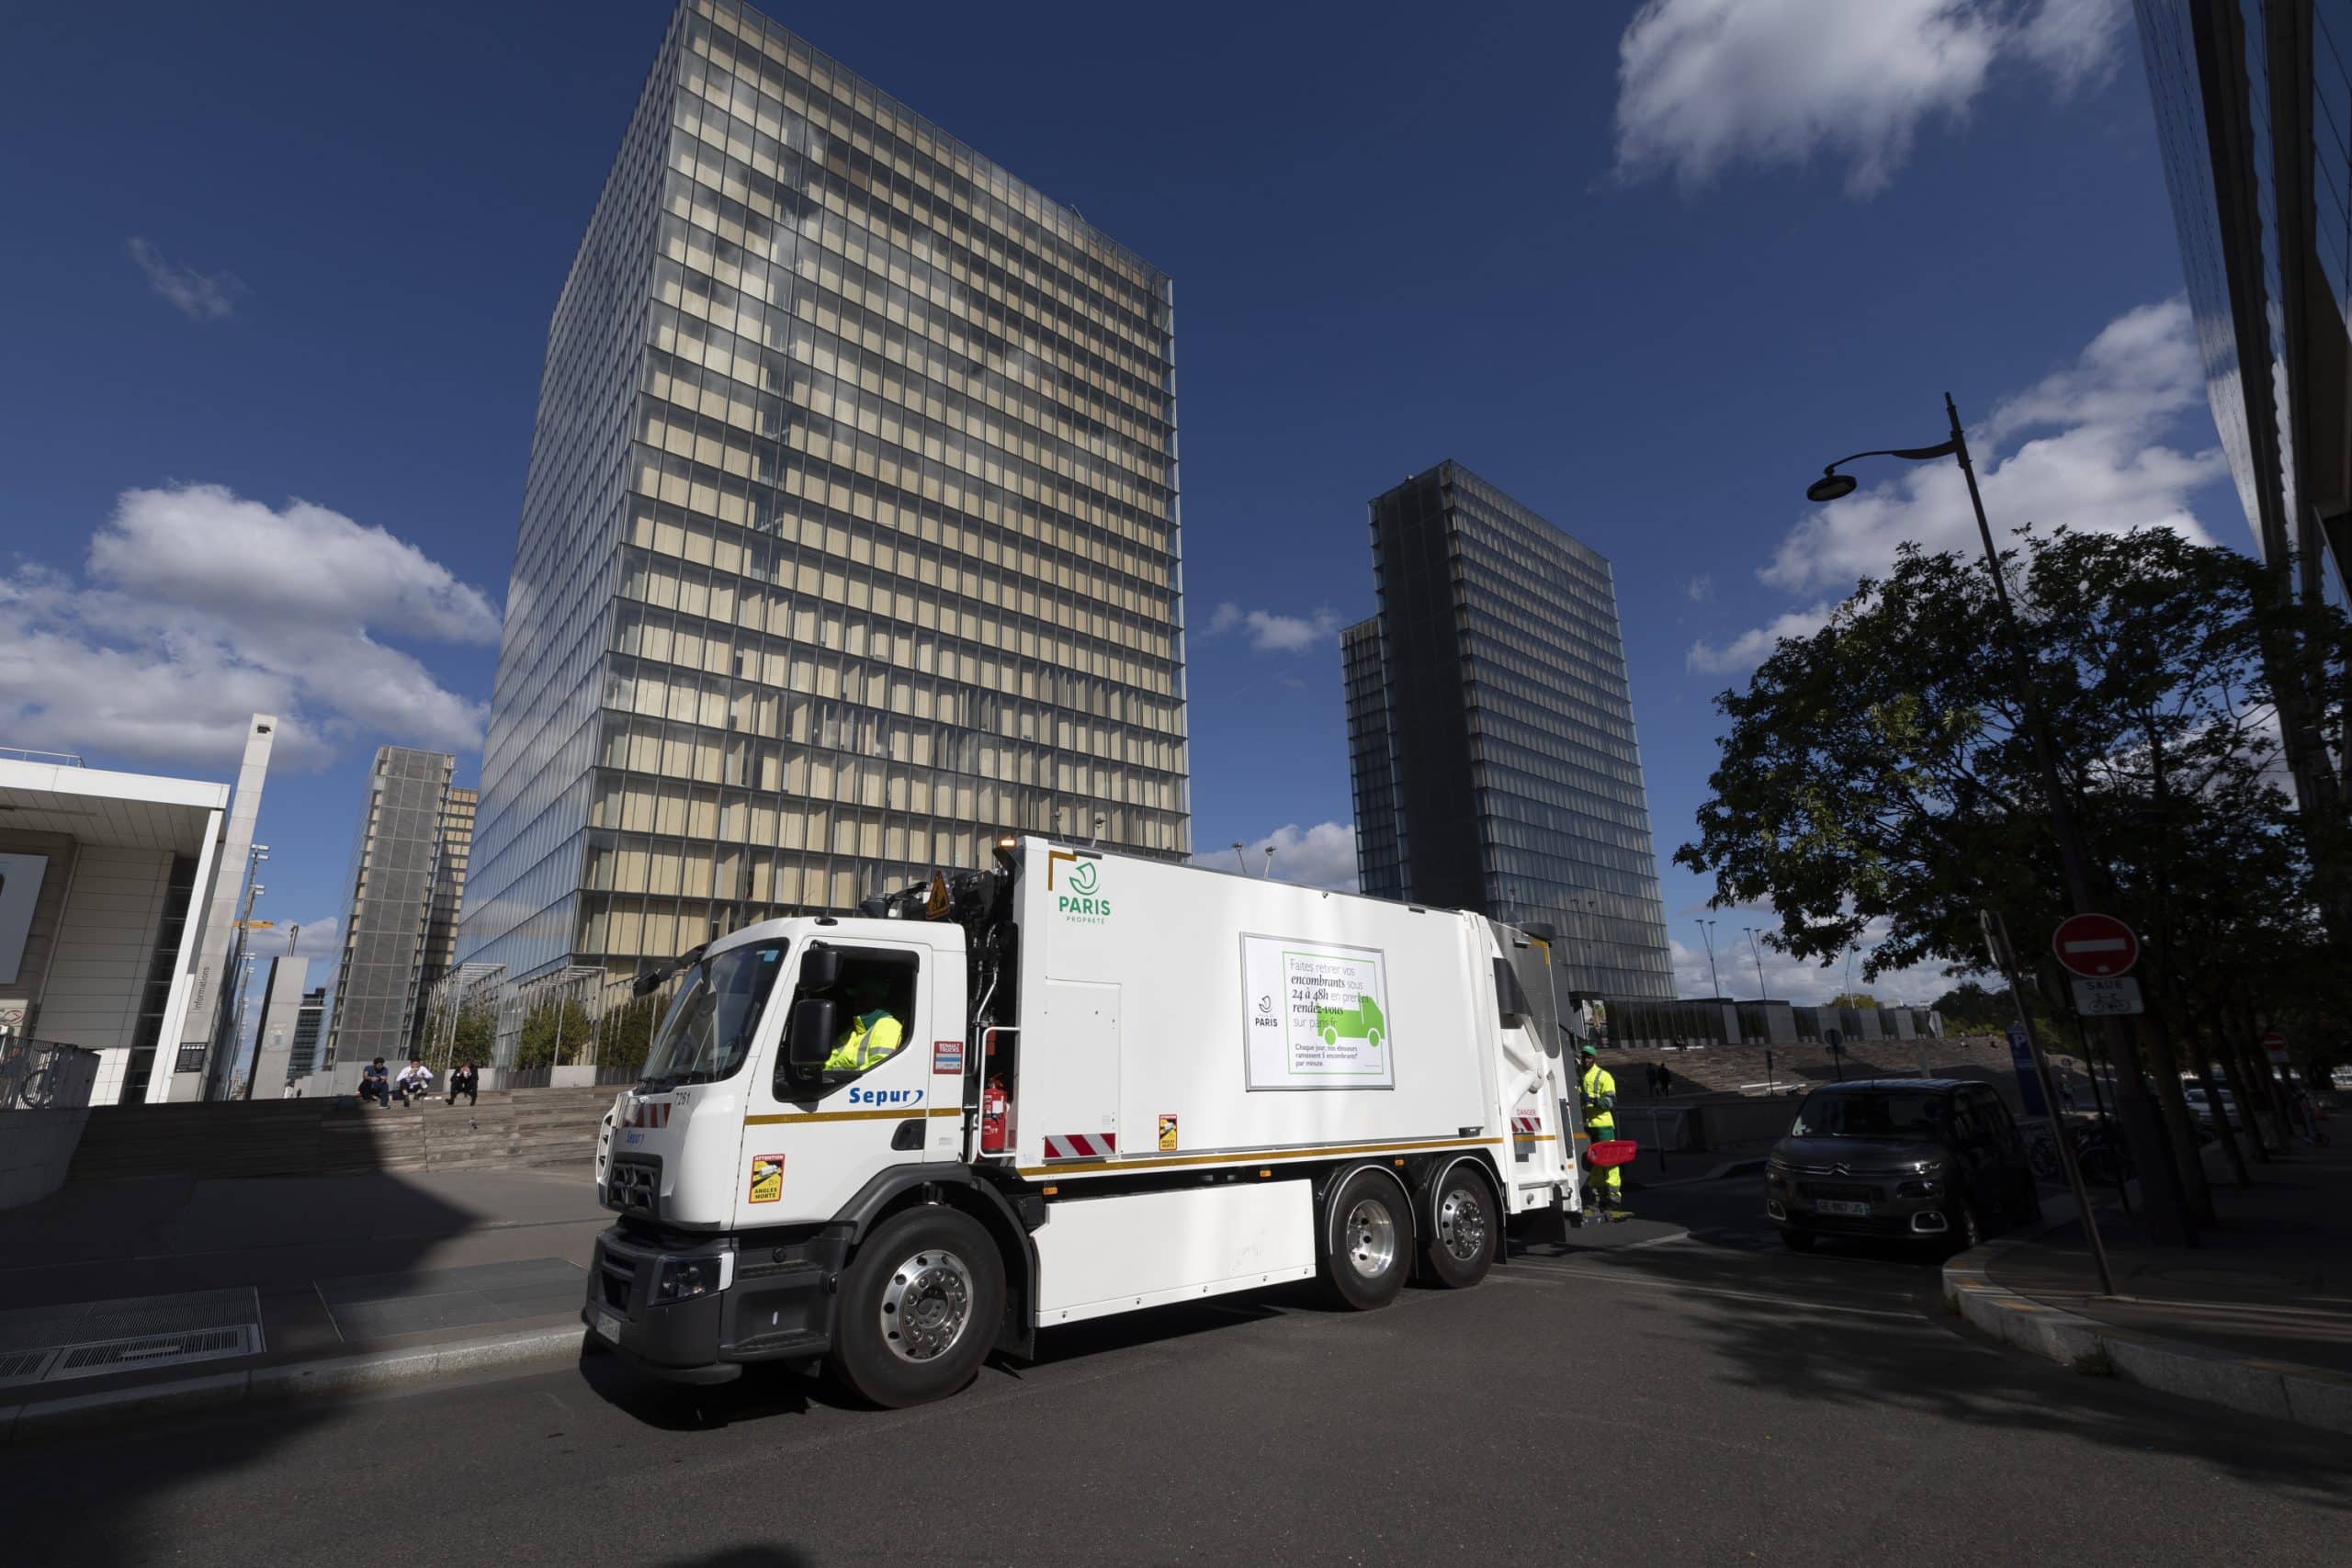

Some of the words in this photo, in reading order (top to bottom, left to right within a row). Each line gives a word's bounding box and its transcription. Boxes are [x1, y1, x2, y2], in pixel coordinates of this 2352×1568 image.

[1058, 896, 1111, 917] PARIS
[1290, 958, 1315, 972] Faites
[1316, 962, 1342, 974] retirer
[1342, 966, 1356, 976] vos
[193, 966, 210, 1010] Informations
[1291, 974, 1345, 988] encombrants
[1347, 980, 1363, 990] sous
[2086, 979, 2123, 990] SAUF
[1292, 988, 1303, 1000] 24
[1313, 988, 1329, 1001] 48h
[1330, 992, 1340, 1001] en
[1293, 1001, 1344, 1016] rendez-vous
[1255, 1017, 1278, 1027] PARIS
[1294, 1018, 1307, 1028] sur
[2013, 1033, 2028, 1048] P
[675, 1091, 691, 1106] 7261
[849, 1087, 910, 1107] Sepur
